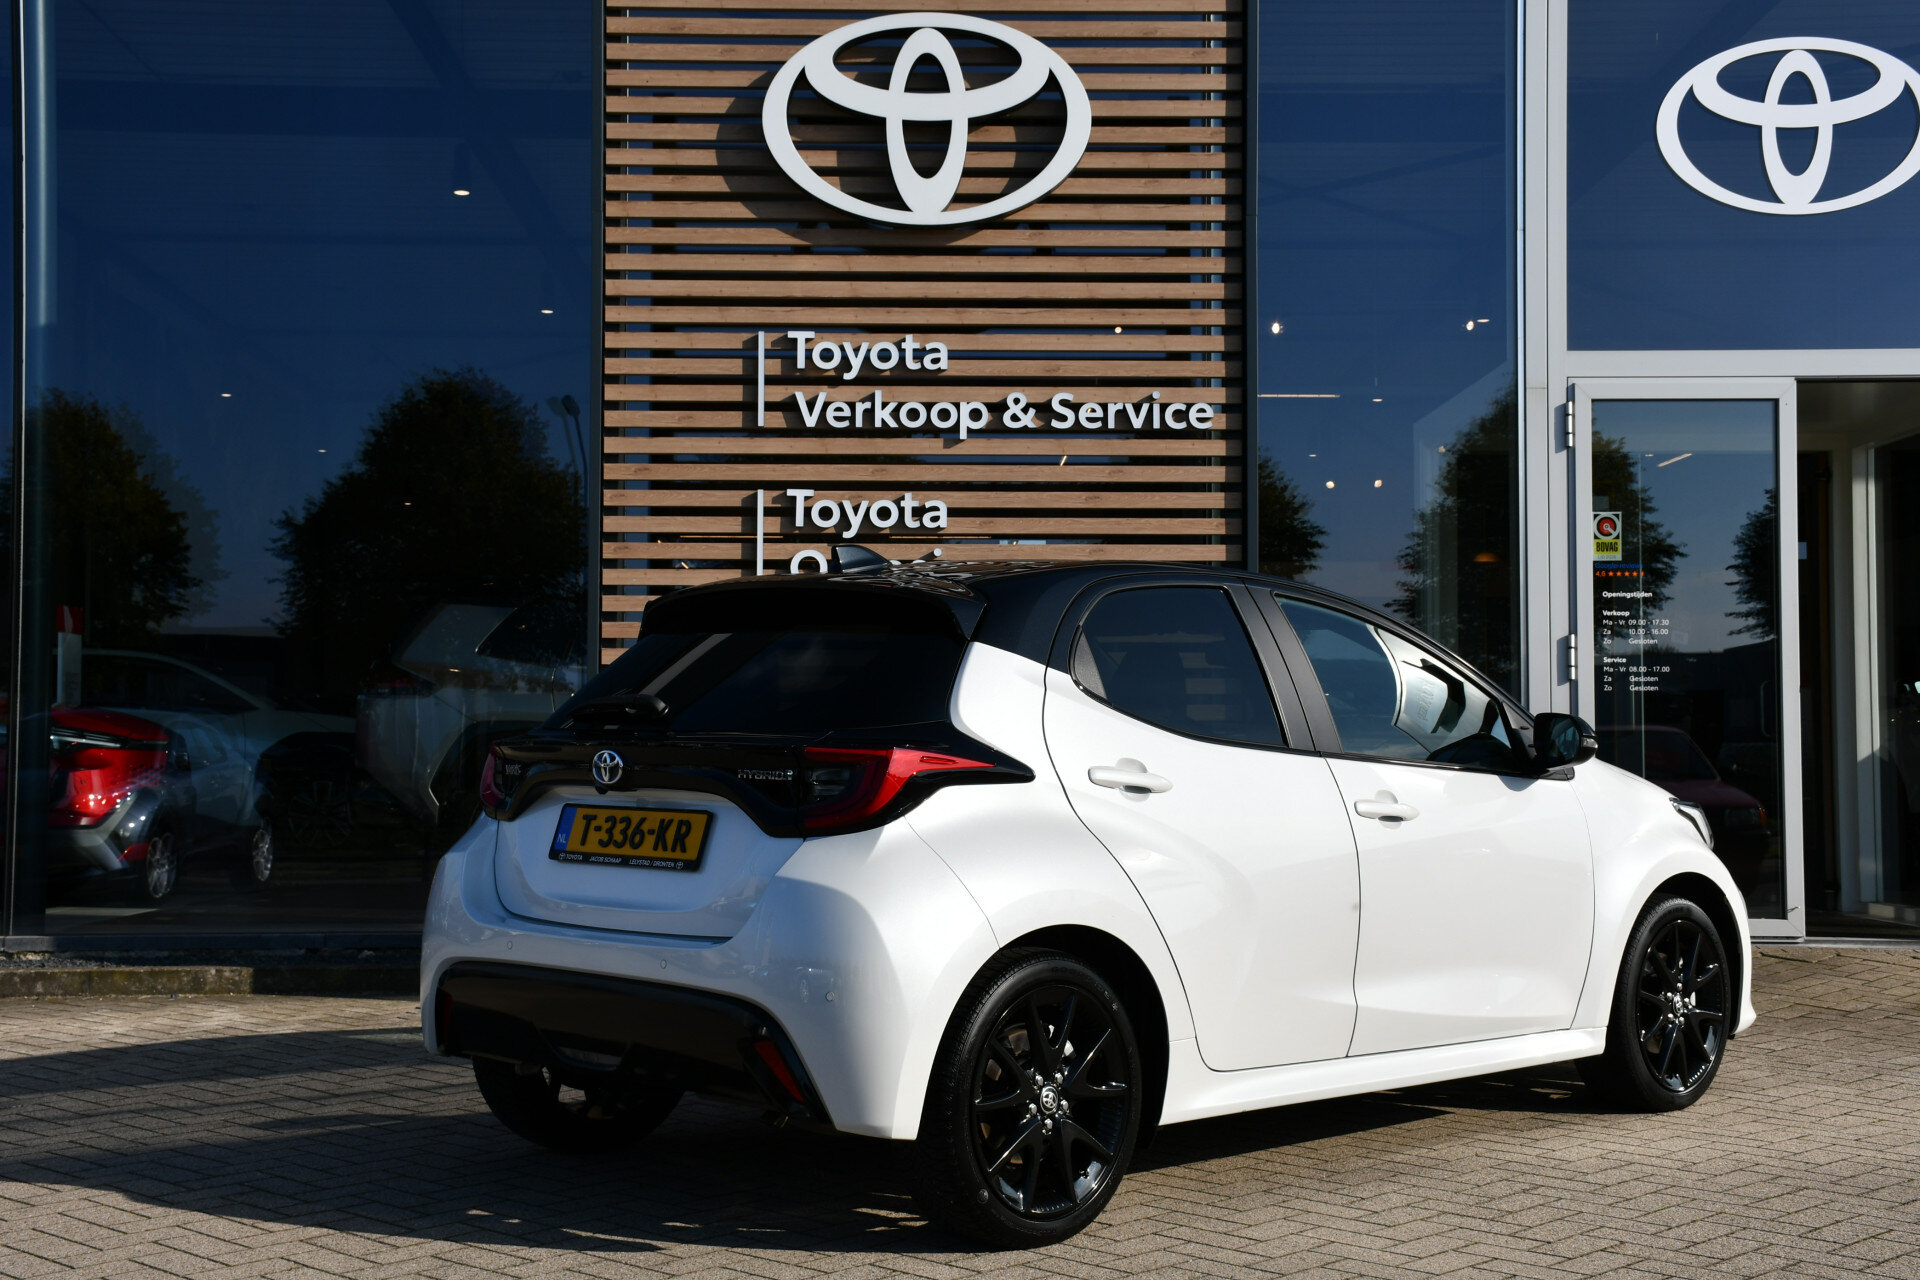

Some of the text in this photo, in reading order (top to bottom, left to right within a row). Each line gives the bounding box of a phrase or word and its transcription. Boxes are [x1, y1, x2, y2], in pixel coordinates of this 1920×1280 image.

[787, 331, 949, 380] Toyota
[794, 390, 1215, 440] Verkoop & Service
[786, 489, 948, 538] Toyota
[1596, 541, 1618, 552] BOVAG
[1602, 590, 1653, 599] Openingstijden
[1602, 609, 1630, 617] Verkoop
[1628, 637, 1658, 645] Gesloten
[738, 769, 786, 781] HYBRID
[557, 833, 567, 844] NL
[580, 814, 692, 853] T-336-KR
